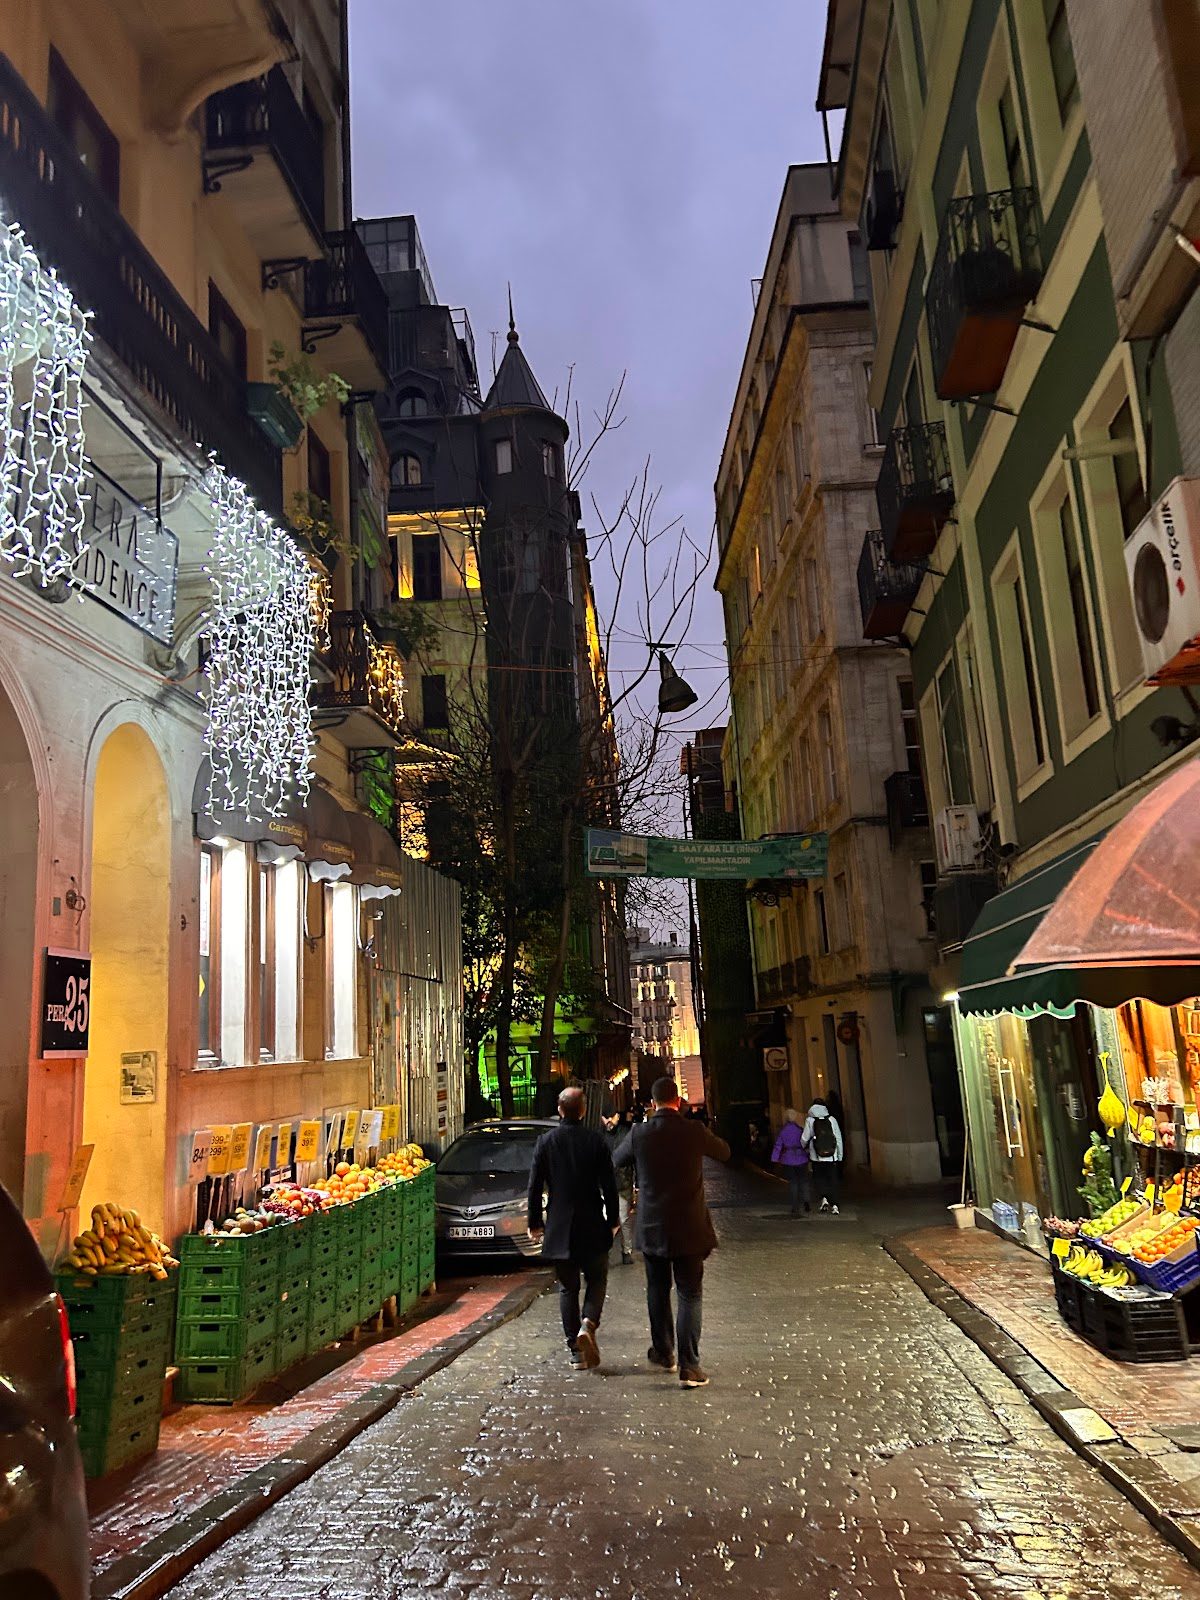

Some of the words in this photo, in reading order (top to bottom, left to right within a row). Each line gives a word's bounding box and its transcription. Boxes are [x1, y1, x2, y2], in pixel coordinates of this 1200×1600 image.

[1161, 501, 1182, 571] arçelik
[678, 844, 703, 853] SAAT
[703, 844, 721, 853] ARA
[47, 1004, 70, 1022] PERA
[64, 975, 89, 1033] 25
